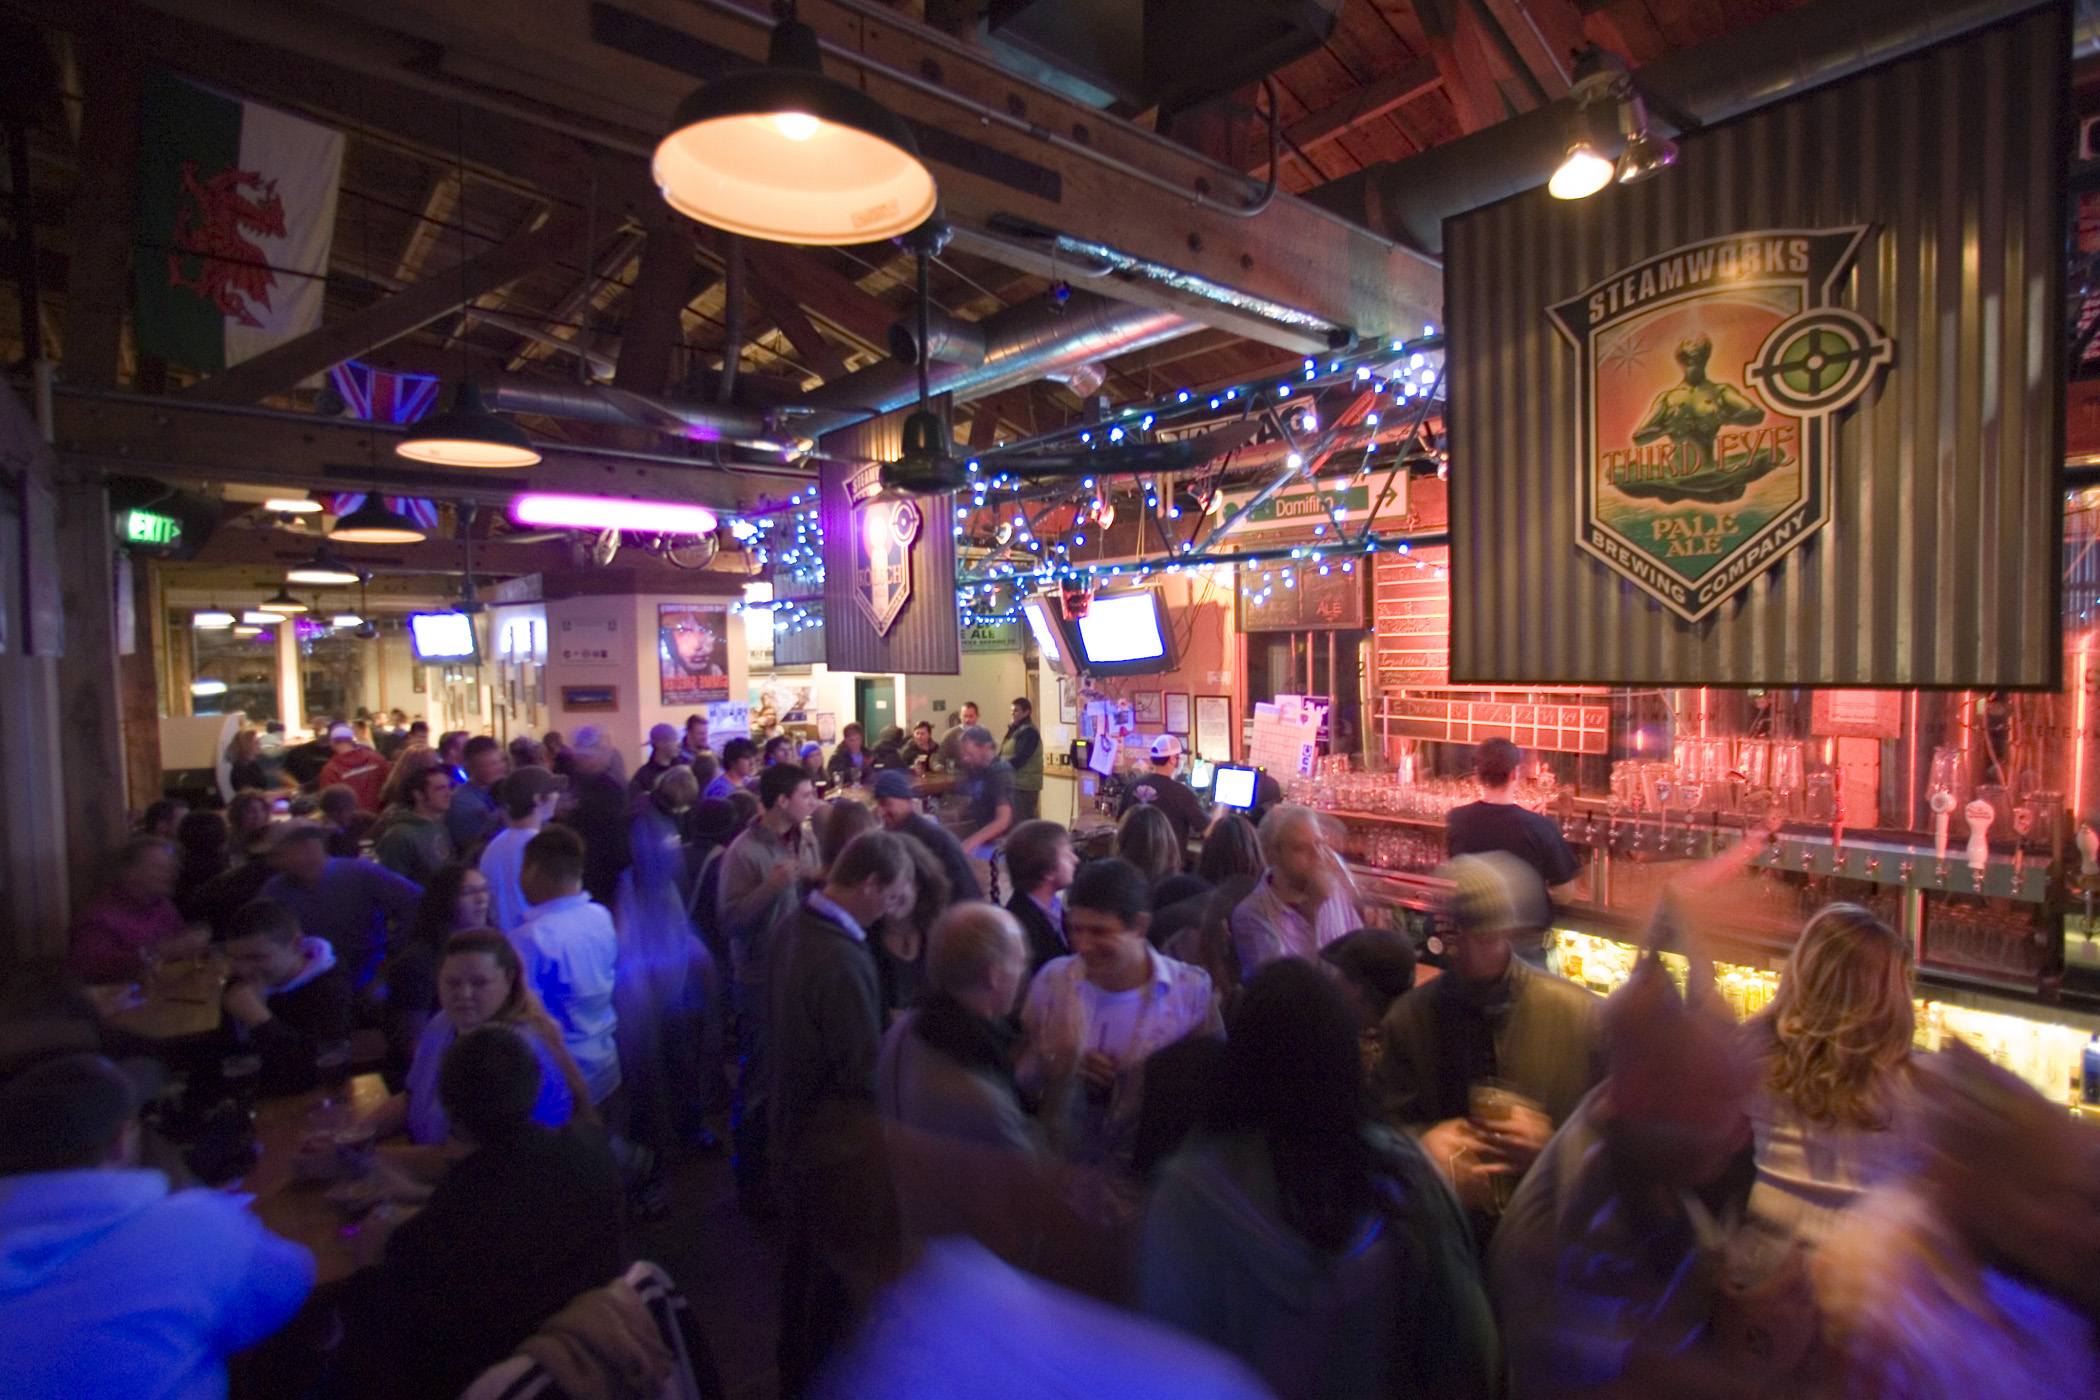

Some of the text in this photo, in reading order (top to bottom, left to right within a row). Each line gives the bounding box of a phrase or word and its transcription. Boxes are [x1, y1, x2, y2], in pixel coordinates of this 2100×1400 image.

[1589, 239, 1808, 324] STEAMWORKS
[1602, 425, 1796, 485] THIRD EYE
[130, 511, 171, 543] EXIT
[1652, 512, 1740, 541] PALE
[1665, 536, 1722, 558] ALE
[1592, 508, 1806, 604] BREWING COMPANY
